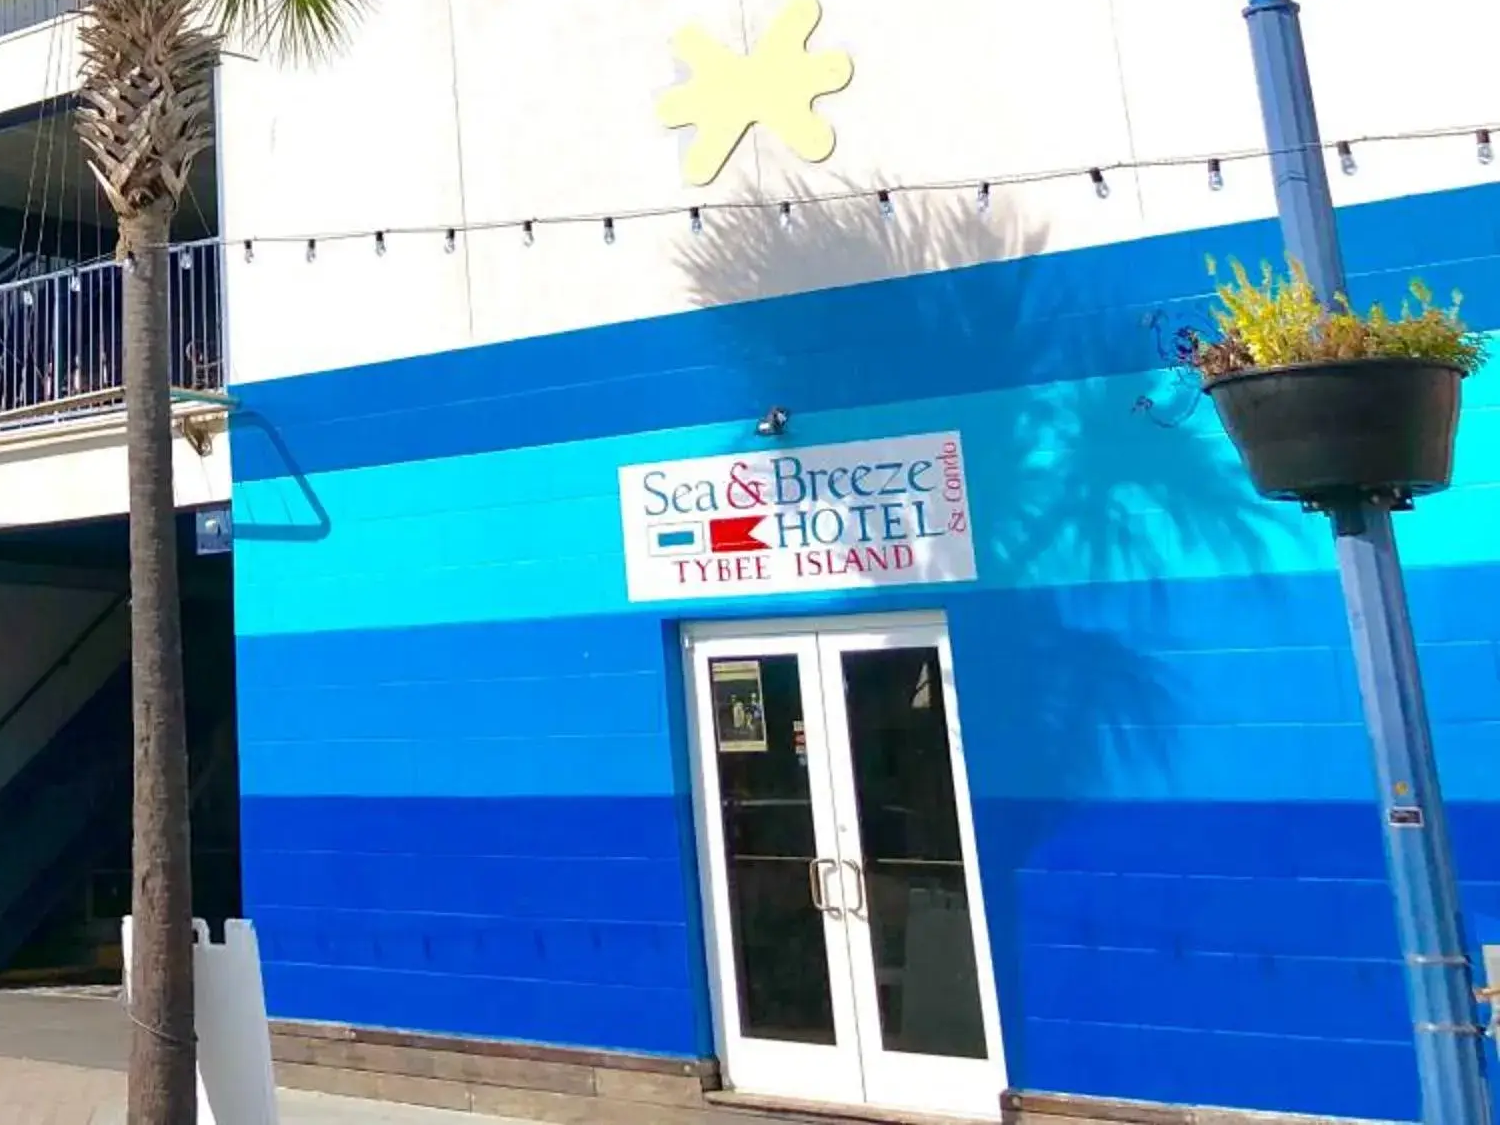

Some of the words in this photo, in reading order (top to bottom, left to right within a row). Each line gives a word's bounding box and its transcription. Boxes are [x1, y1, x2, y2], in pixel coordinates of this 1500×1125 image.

[643, 470, 719, 517] Sea
[726, 462, 767, 510] &
[770, 456, 935, 506] Breeze
[774, 501, 945, 549] HOTEL
[674, 555, 771, 584] TYBEE
[794, 544, 915, 577] ISLAND
